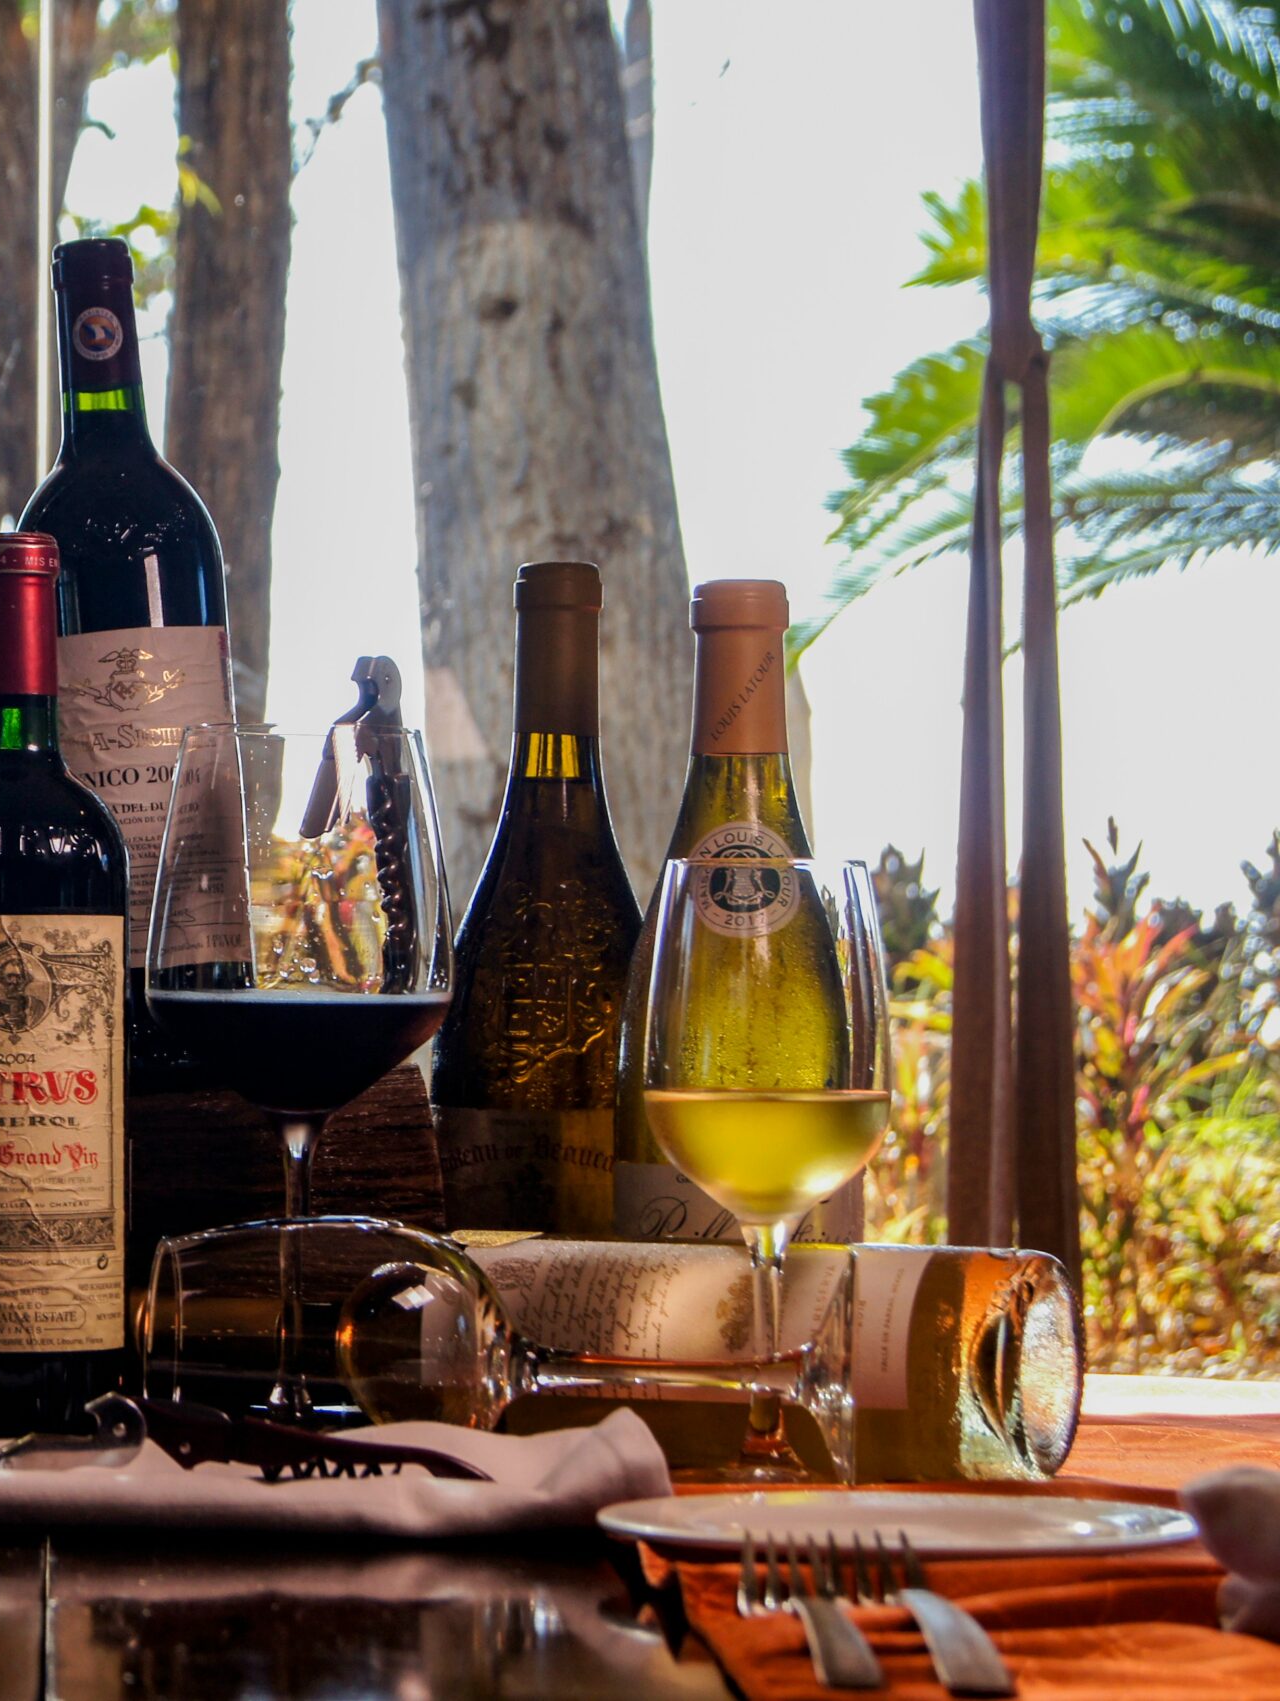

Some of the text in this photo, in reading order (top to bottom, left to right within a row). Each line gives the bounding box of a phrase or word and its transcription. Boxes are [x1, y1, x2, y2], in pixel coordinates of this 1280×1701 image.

[24, 555, 46, 567] MIS
[738, 651, 775, 704] LATOUR
[713, 831, 765, 848] LOUIS
[34, 1310, 78, 1323] ESTATE
